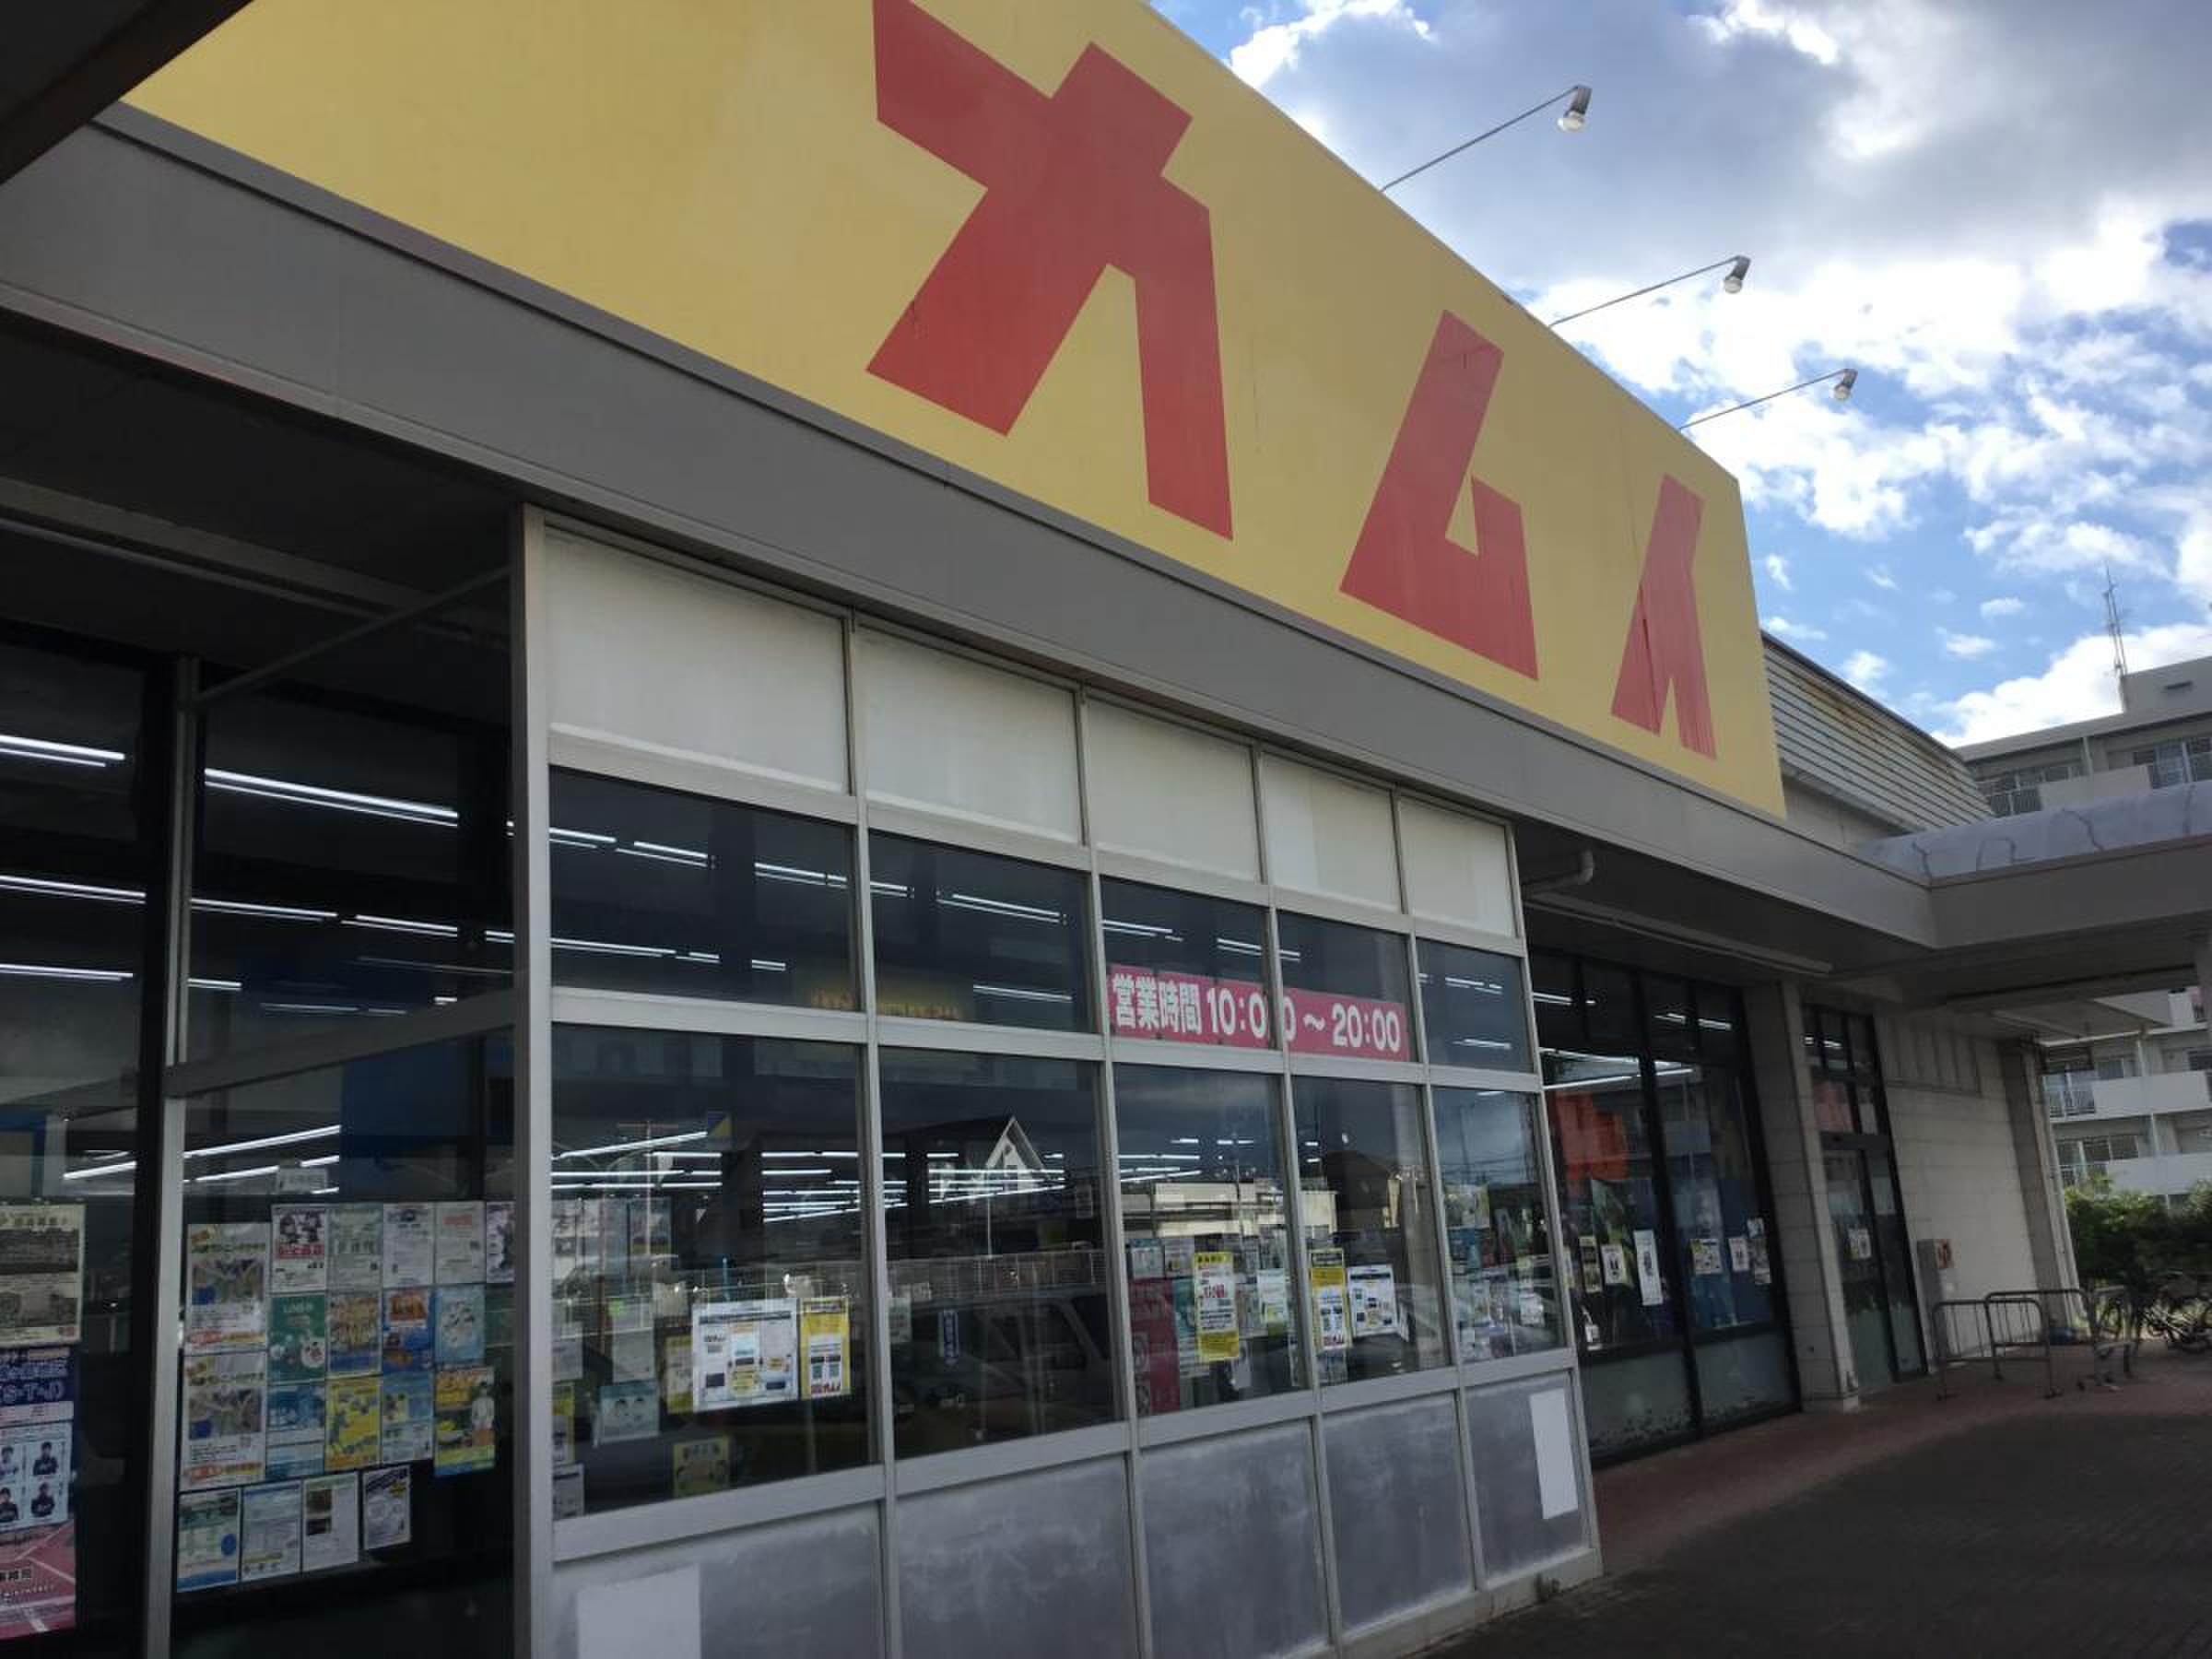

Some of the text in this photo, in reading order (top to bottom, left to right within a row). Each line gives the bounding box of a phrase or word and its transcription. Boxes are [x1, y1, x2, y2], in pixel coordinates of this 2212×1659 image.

[866, 0, 1718, 759] カムイ
[1112, 972, 1203, 1035] 営業時間
